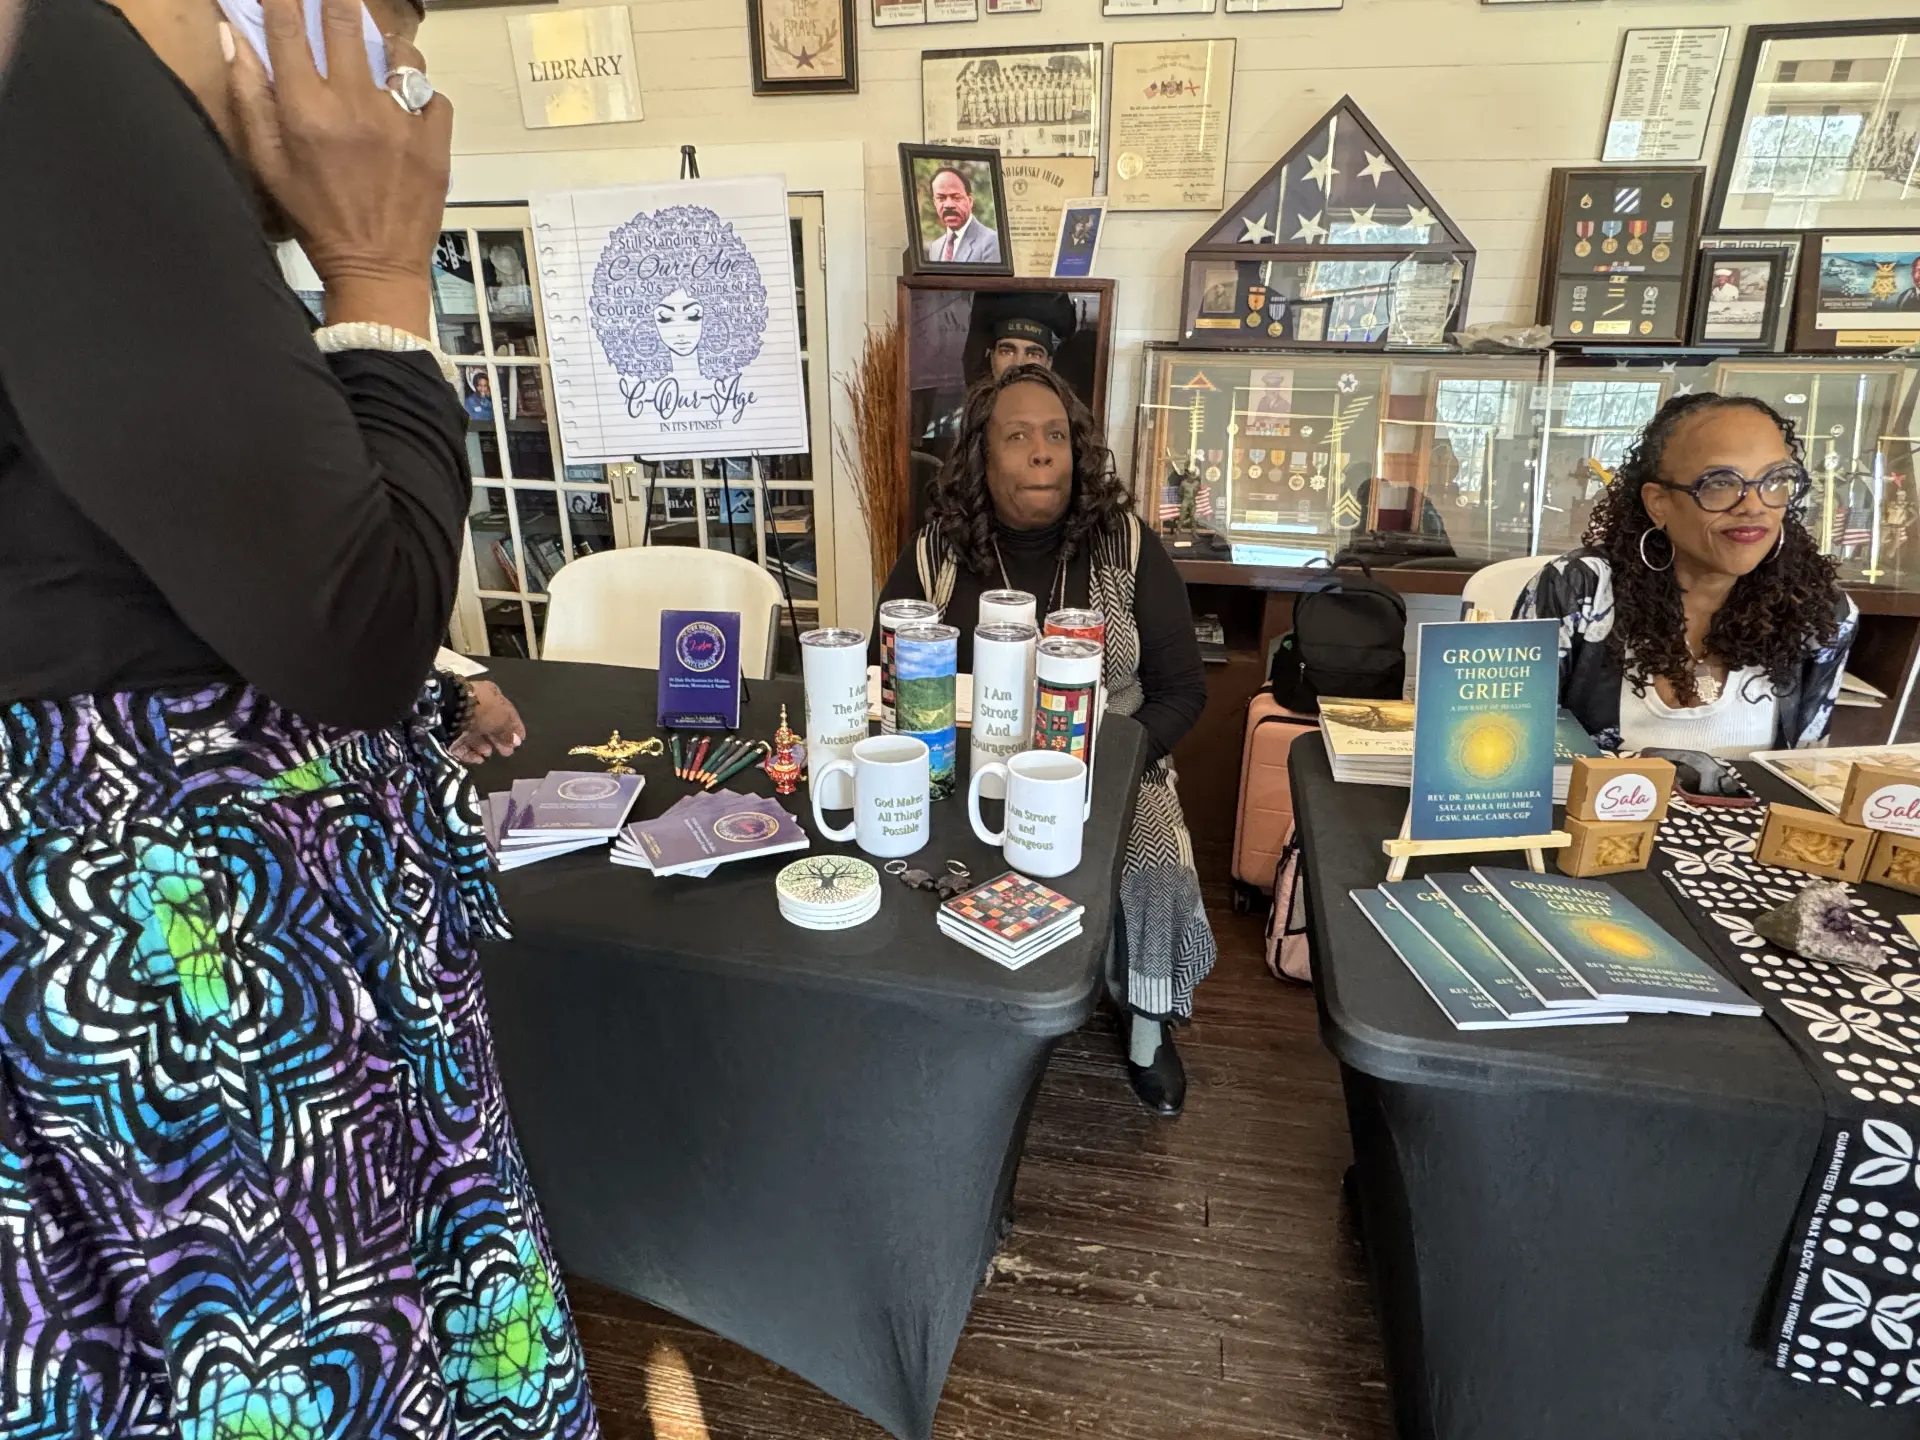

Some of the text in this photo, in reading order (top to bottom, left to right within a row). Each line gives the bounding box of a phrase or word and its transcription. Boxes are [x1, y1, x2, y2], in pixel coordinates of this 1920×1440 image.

[528, 54, 622, 82] LIBRARY
[618, 236, 641, 250] Still
[645, 233, 700, 249] Standing
[605, 281, 663, 297] Fiery 50's
[689, 280, 751, 295] Sizzling 60's
[597, 303, 651, 319] Courage
[1024, 323, 1043, 336] NAVY
[625, 361, 647, 373] Fiery
[619, 373, 758, 424] C-Our-Age
[659, 422, 671, 433] IN
[689, 419, 723, 431] FINEST
[1442, 646, 1542, 664] GROWING
[1455, 665, 1531, 680] THROUGH
[849, 686, 854, 698] I
[984, 685, 1012, 701] I Am
[1459, 682, 1525, 700] GRIEF
[832, 703, 853, 715] The
[980, 706, 1019, 721] Strong
[847, 717, 860, 729] To
[986, 724, 1011, 737] And
[971, 734, 1028, 757] Courageous
[874, 794, 923, 809] God Makes
[1427, 794, 1446, 802] REV.
[1512, 790, 1542, 799] IMARA
[1600, 784, 1651, 809] Sala
[878, 808, 923, 822] All Things
[1011, 803, 1023, 818] Am
[1024, 809, 1056, 825] Strong
[1438, 803, 1461, 812] SALA
[1463, 802, 1494, 811] IMARA
[1513, 811, 1531, 820] CGP
[882, 823, 920, 836] Possible
[1018, 823, 1036, 836] and
[1510, 880, 1611, 900] GROWING
[1530, 890, 1611, 907] THROUGH
[1547, 900, 1613, 917] GRIEF
[1822, 1131, 1850, 1192] GUARANTEED
[1814, 1193, 1832, 1216] REAL
[1807, 1216, 1824, 1238] WAX
[1798, 1238, 1817, 1270] BLOCK
[1791, 1270, 1809, 1300] PRINTS
[1780, 1301, 1801, 1341] HITARGET
